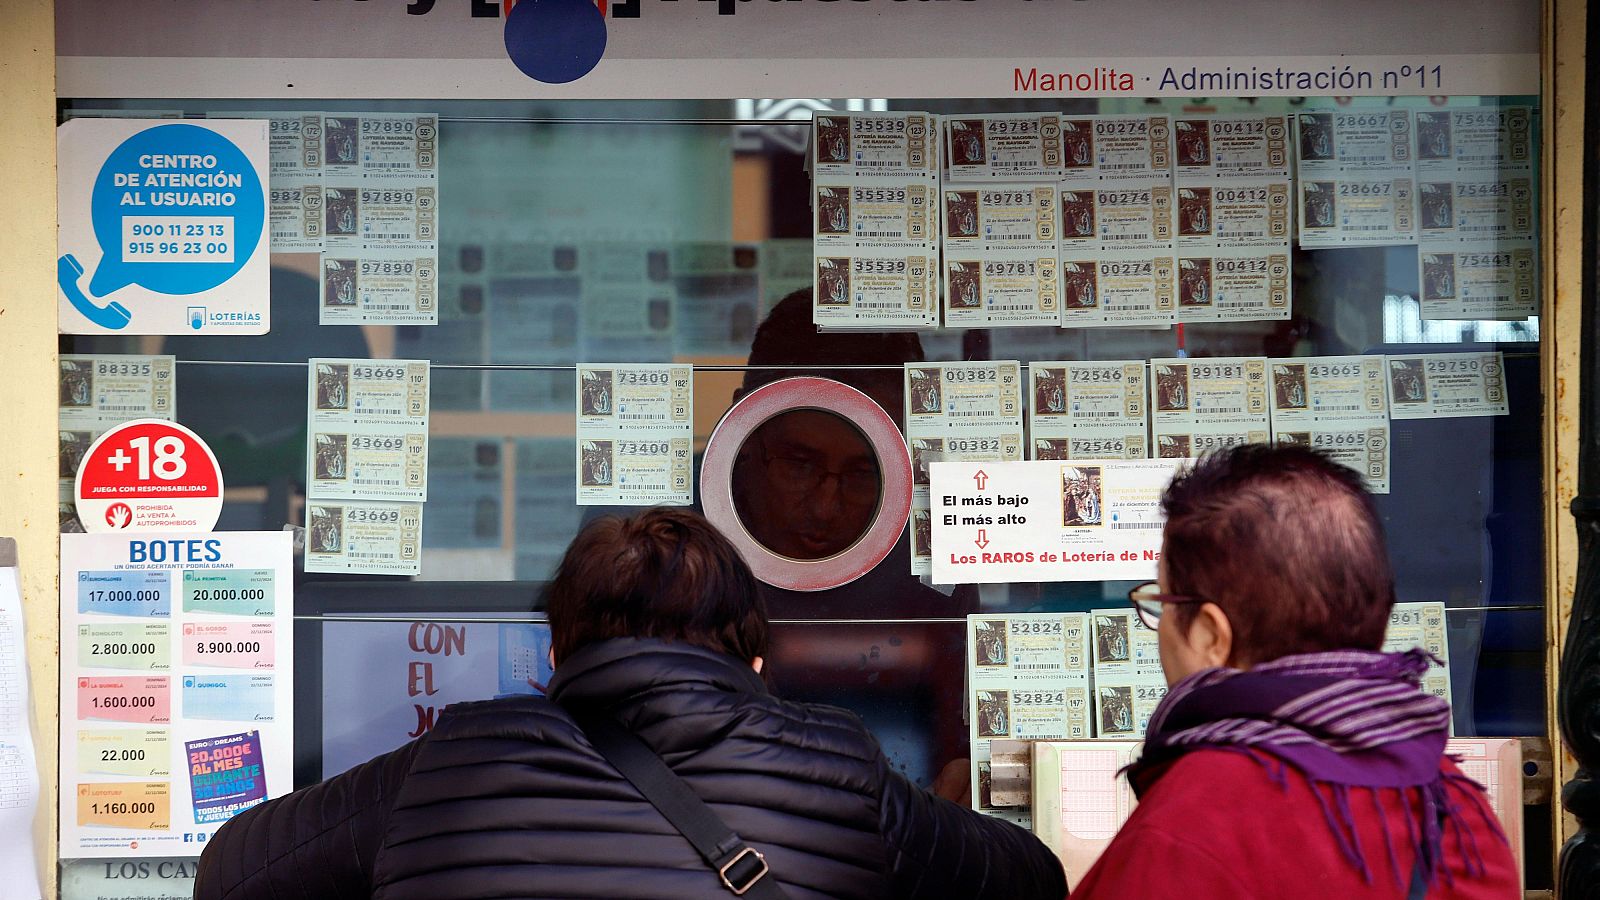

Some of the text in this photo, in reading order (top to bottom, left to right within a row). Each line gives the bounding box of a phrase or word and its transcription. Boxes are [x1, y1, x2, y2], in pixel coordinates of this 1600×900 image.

[1014, 65, 1440, 91] Manolita Administración nº11
[855, 120, 905, 131] 35539
[1337, 115, 1387, 127] 28667
[1456, 114, 1505, 126] 75441
[270, 121, 300, 132] 982
[362, 121, 413, 132] 97890
[989, 120, 1039, 133] 49781
[1096, 122, 1147, 134] 00274
[1213, 121, 1264, 134] 00412
[139, 155, 217, 169] CENTRO
[114, 170, 242, 187] DE ATENCIÓN
[855, 190, 905, 201] 35539
[1340, 184, 1390, 195] 28667
[1458, 183, 1508, 196] 75441
[120, 192, 235, 206] AL USUARIO
[271, 192, 300, 201] 982
[362, 192, 413, 202] 97890
[983, 192, 1033, 204] 49781
[1099, 193, 1150, 205] 00274
[1216, 190, 1266, 202] 00412
[133, 225, 224, 236] 900 11 23 13
[129, 242, 227, 254] 915 96 23 00
[362, 263, 413, 273] 97890
[855, 261, 905, 272] 35539
[985, 263, 1035, 275] 49781
[1101, 264, 1151, 276] 00274
[1216, 260, 1267, 273] 00412
[210, 312, 261, 321] LOTERÍAS
[99, 364, 150, 374] 88335
[1193, 367, 1243, 377] 99181
[1310, 366, 1360, 376] 43665
[1428, 361, 1478, 371] 29750
[354, 368, 404, 378] 43669
[619, 374, 669, 383] 73400
[946, 370, 996, 380] 00382
[1072, 370, 1122, 382] 72546
[352, 438, 402, 448] 43669
[1195, 437, 1245, 449] 99181
[1315, 434, 1365, 444] 43665
[619, 444, 669, 453] 73400
[950, 440, 999, 451] 00382
[1073, 441, 1122, 452] 72546
[108, 436, 187, 481] +18
[943, 494, 1029, 508] El más bajo
[348, 511, 398, 521] 43669
[943, 513, 1027, 526] El más alto
[130, 540, 221, 563] BOTES
[951, 550, 1161, 565] Los RAROS de Lotería de Na
[89, 590, 160, 602] 17.000.000
[193, 589, 264, 601] 20.000.000
[1391, 613, 1420, 624] 961
[1012, 623, 1061, 633] 52824
[408, 622, 465, 656] CON
[92, 643, 155, 655] 2.800.000
[197, 641, 260, 653] 8.900.000
[408, 662, 439, 697] EL
[92, 696, 155, 708] 1.600.000
[1014, 694, 1064, 704] 52824
[215, 736, 243, 746] DREAMS
[101, 749, 145, 761] 22.000
[191, 743, 252, 764] 20.000€
[192, 757, 243, 775] AL MES
[193, 764, 261, 786] DURANTE
[92, 803, 155, 814] 1.160.000
[197, 806, 223, 815] TODOS
[223, 803, 238, 812] LOS
[239, 798, 264, 809] LUNES
[204, 811, 234, 820] JUEVES
[105, 862, 150, 879] LOS
